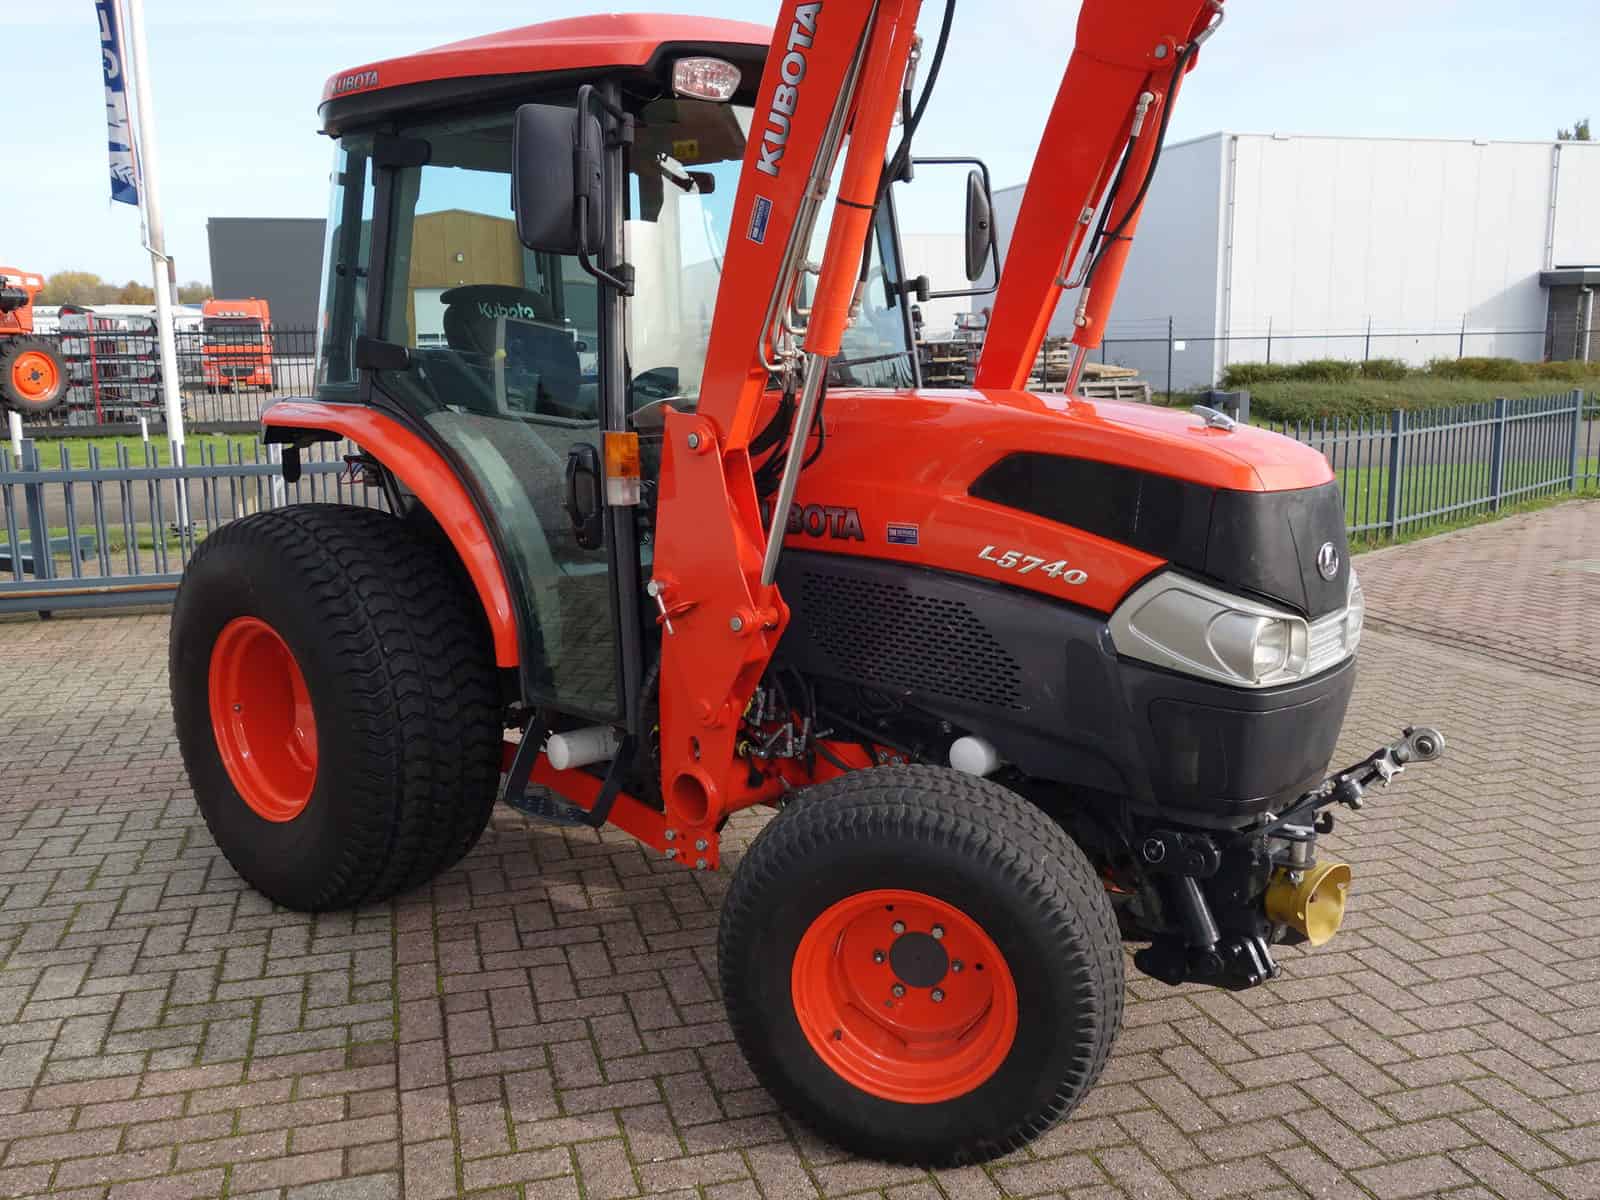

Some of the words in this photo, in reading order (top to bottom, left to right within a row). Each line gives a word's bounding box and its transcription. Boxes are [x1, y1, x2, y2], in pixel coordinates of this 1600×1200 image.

[756, 1, 822, 176] KUBOTA
[478, 302, 535, 319] Kubota
[978, 545, 1088, 584] L5740
